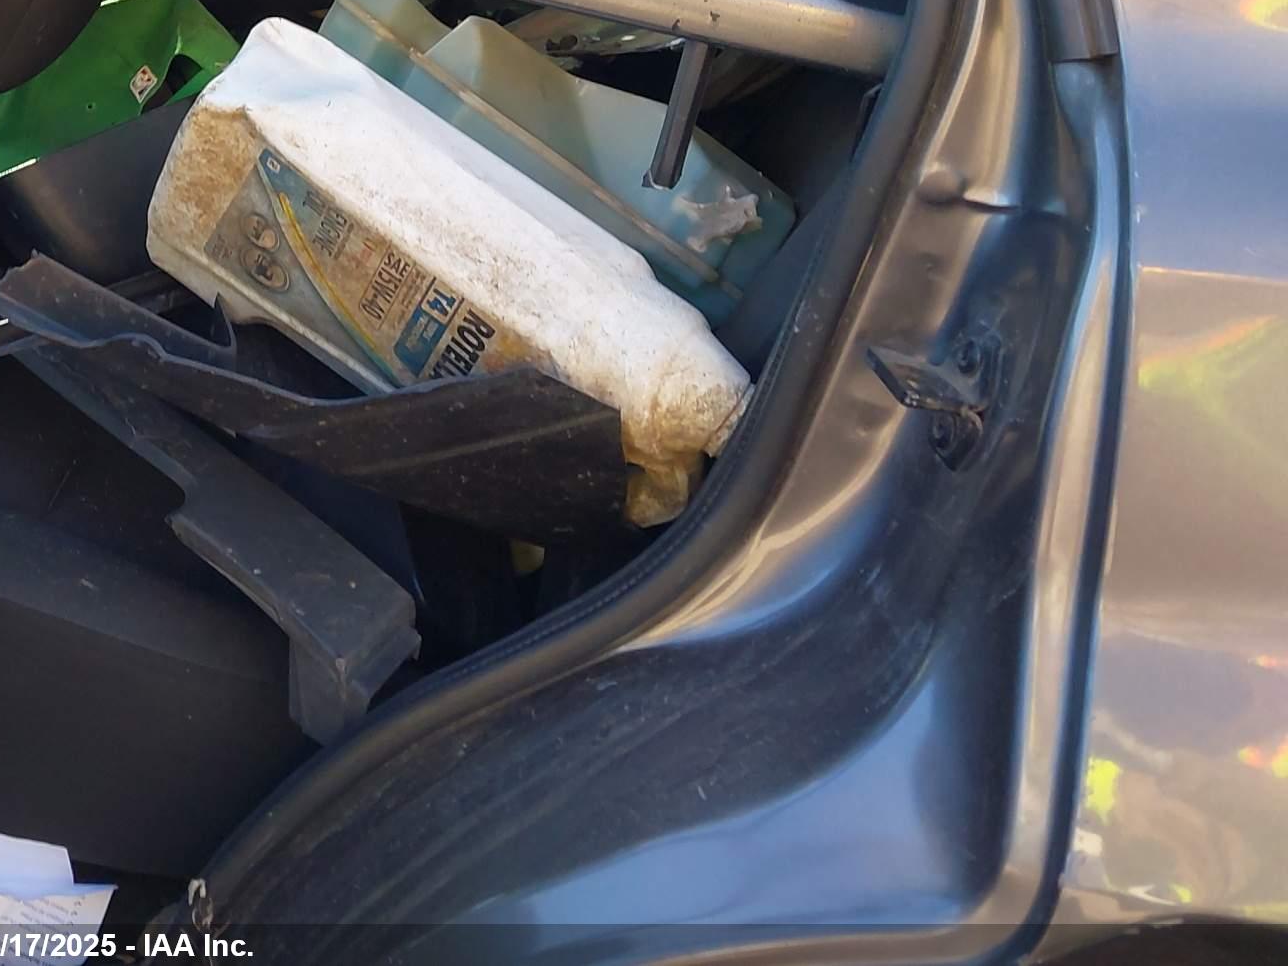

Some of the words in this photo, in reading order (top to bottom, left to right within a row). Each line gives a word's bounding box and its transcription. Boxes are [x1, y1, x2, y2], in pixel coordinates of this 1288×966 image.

[310, 212, 349, 258] ENGINE
[382, 252, 411, 276] SAE
[362, 267, 404, 322] 15W-40
[427, 287, 457, 317] T4
